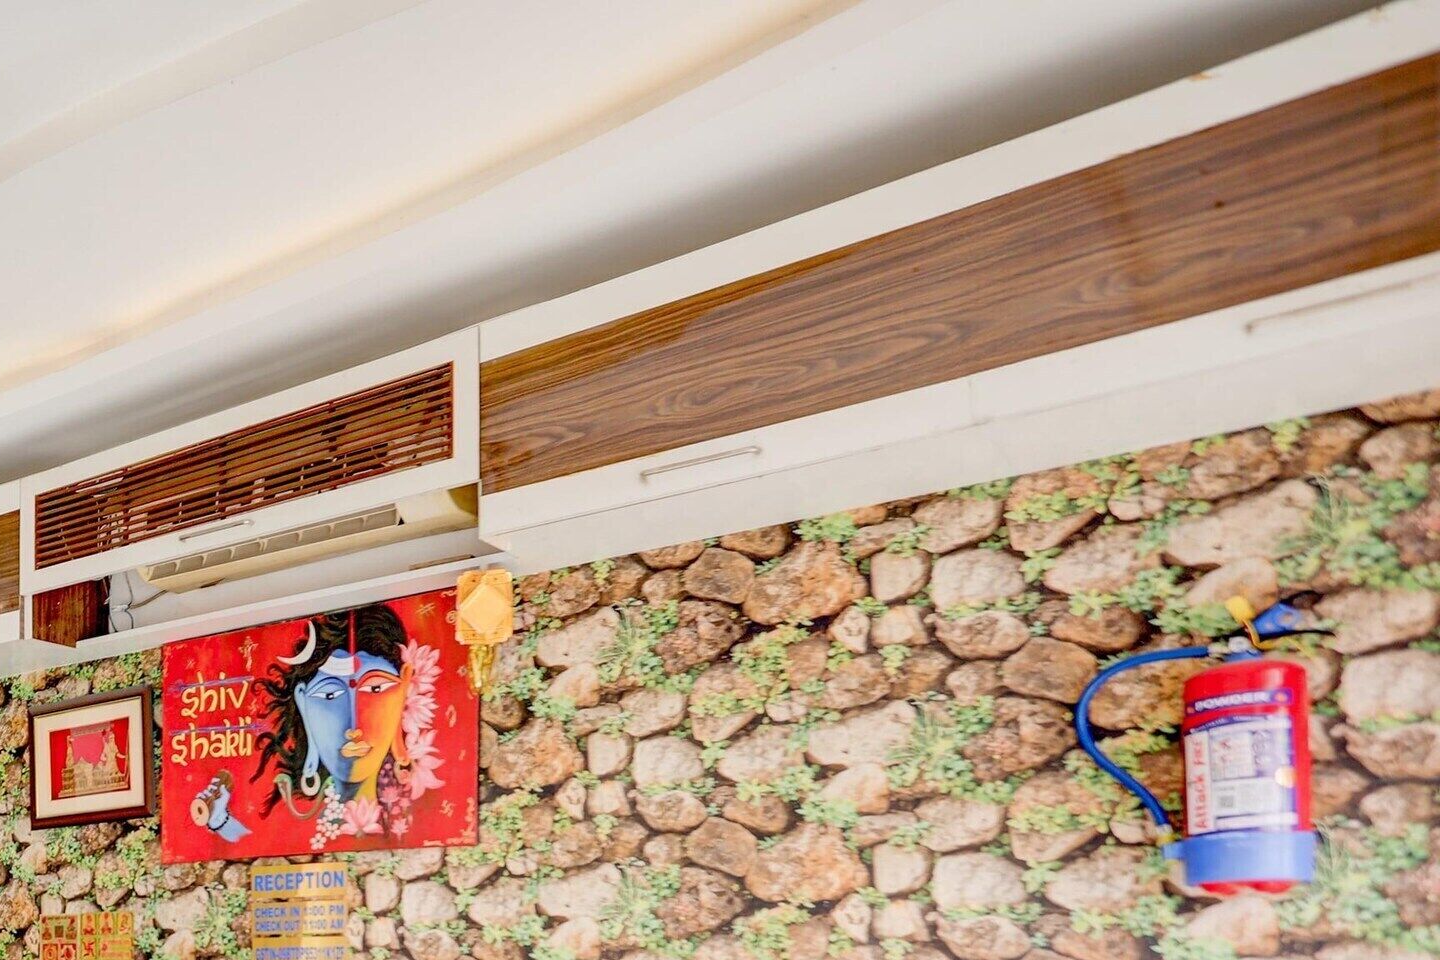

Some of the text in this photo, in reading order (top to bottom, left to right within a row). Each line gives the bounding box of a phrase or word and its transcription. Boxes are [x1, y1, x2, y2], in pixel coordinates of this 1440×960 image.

[1194, 691, 1270, 712] POWDER
[254, 871, 344, 891] RECEPTION
[255, 907, 286, 918] CHECK
[290, 906, 300, 917] IN
[329, 904, 344, 915] PM
[255, 920, 281, 932] CHECK
[283, 920, 300, 931] OUT
[330, 918, 344, 929] AM
